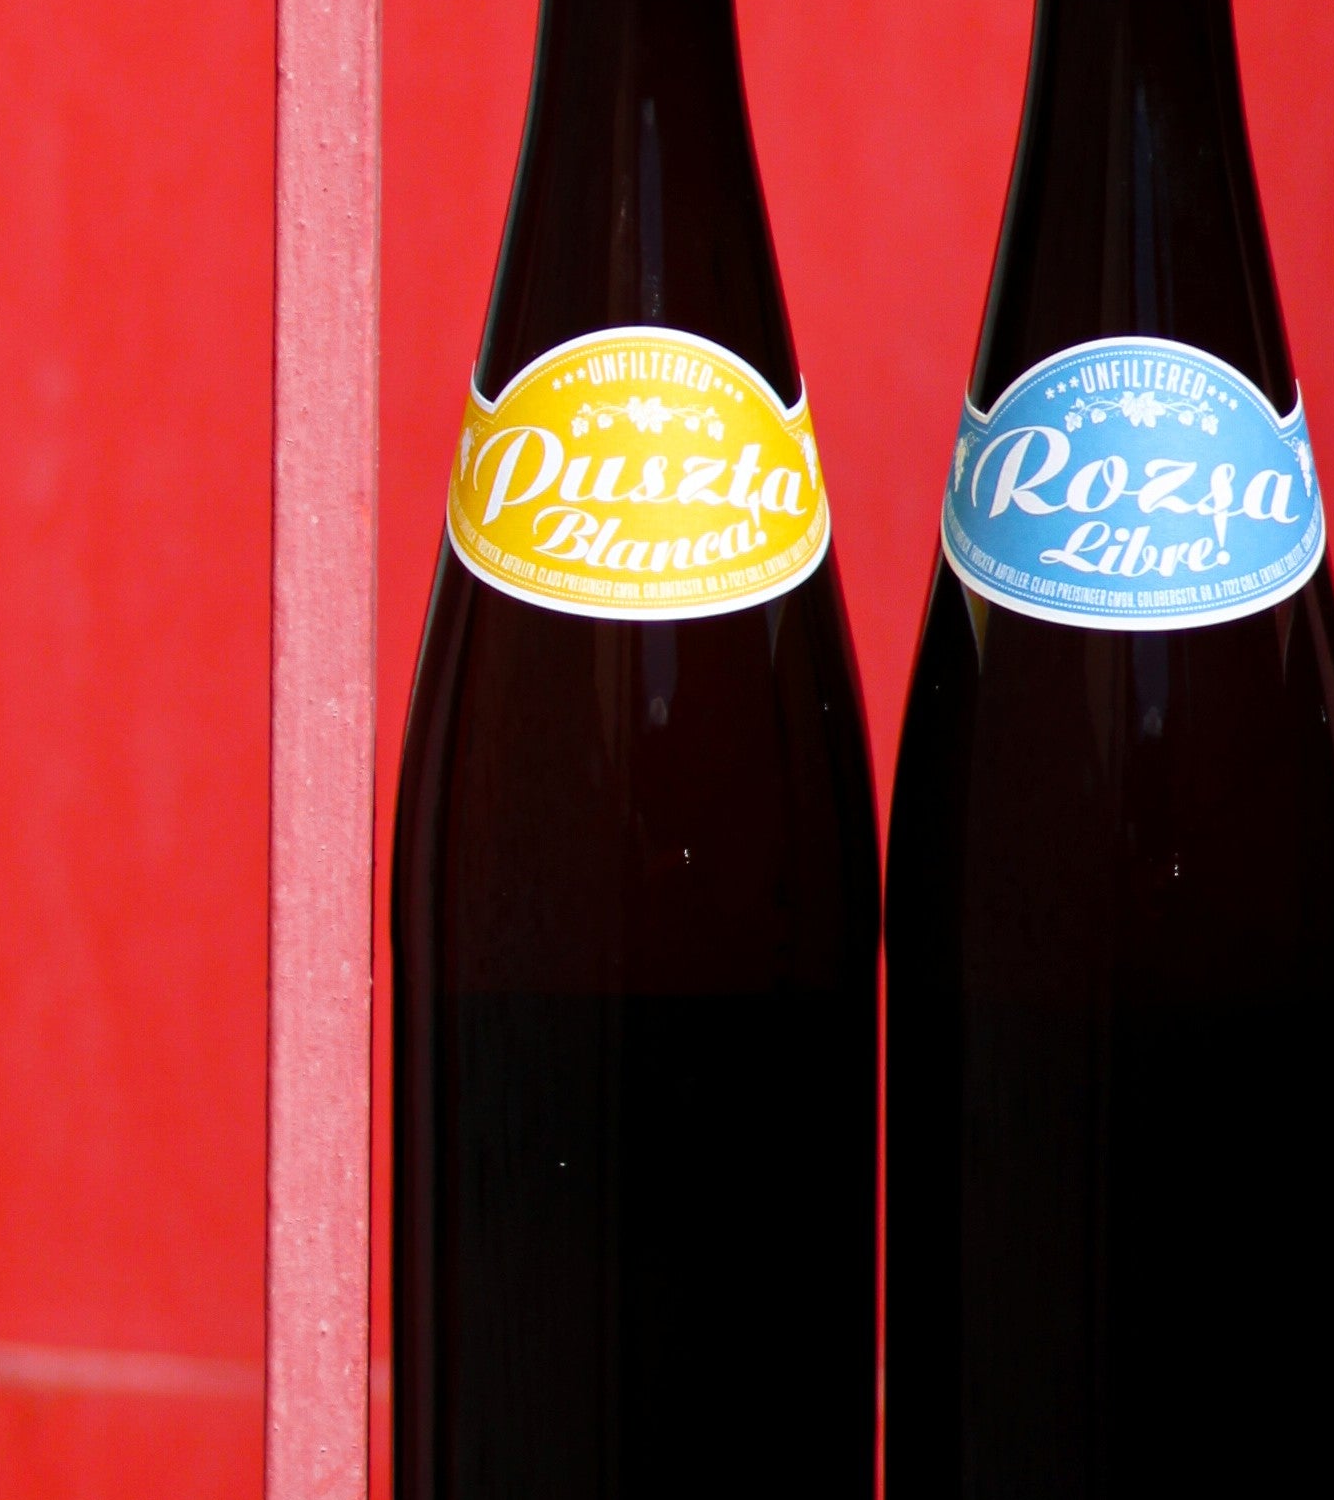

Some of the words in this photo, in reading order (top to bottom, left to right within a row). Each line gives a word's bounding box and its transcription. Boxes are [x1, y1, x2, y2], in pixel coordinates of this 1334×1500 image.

[588, 352, 714, 393] UNFILTERED
[1079, 360, 1209, 400] UNFILTERED
[473, 426, 807, 526] Puszta
[971, 425, 1301, 524] Rozsa
[1039, 512, 1231, 577] Libre!
[1030, 576, 1056, 597] CLAUS
[1057, 582, 1106, 605] PREISINGER
